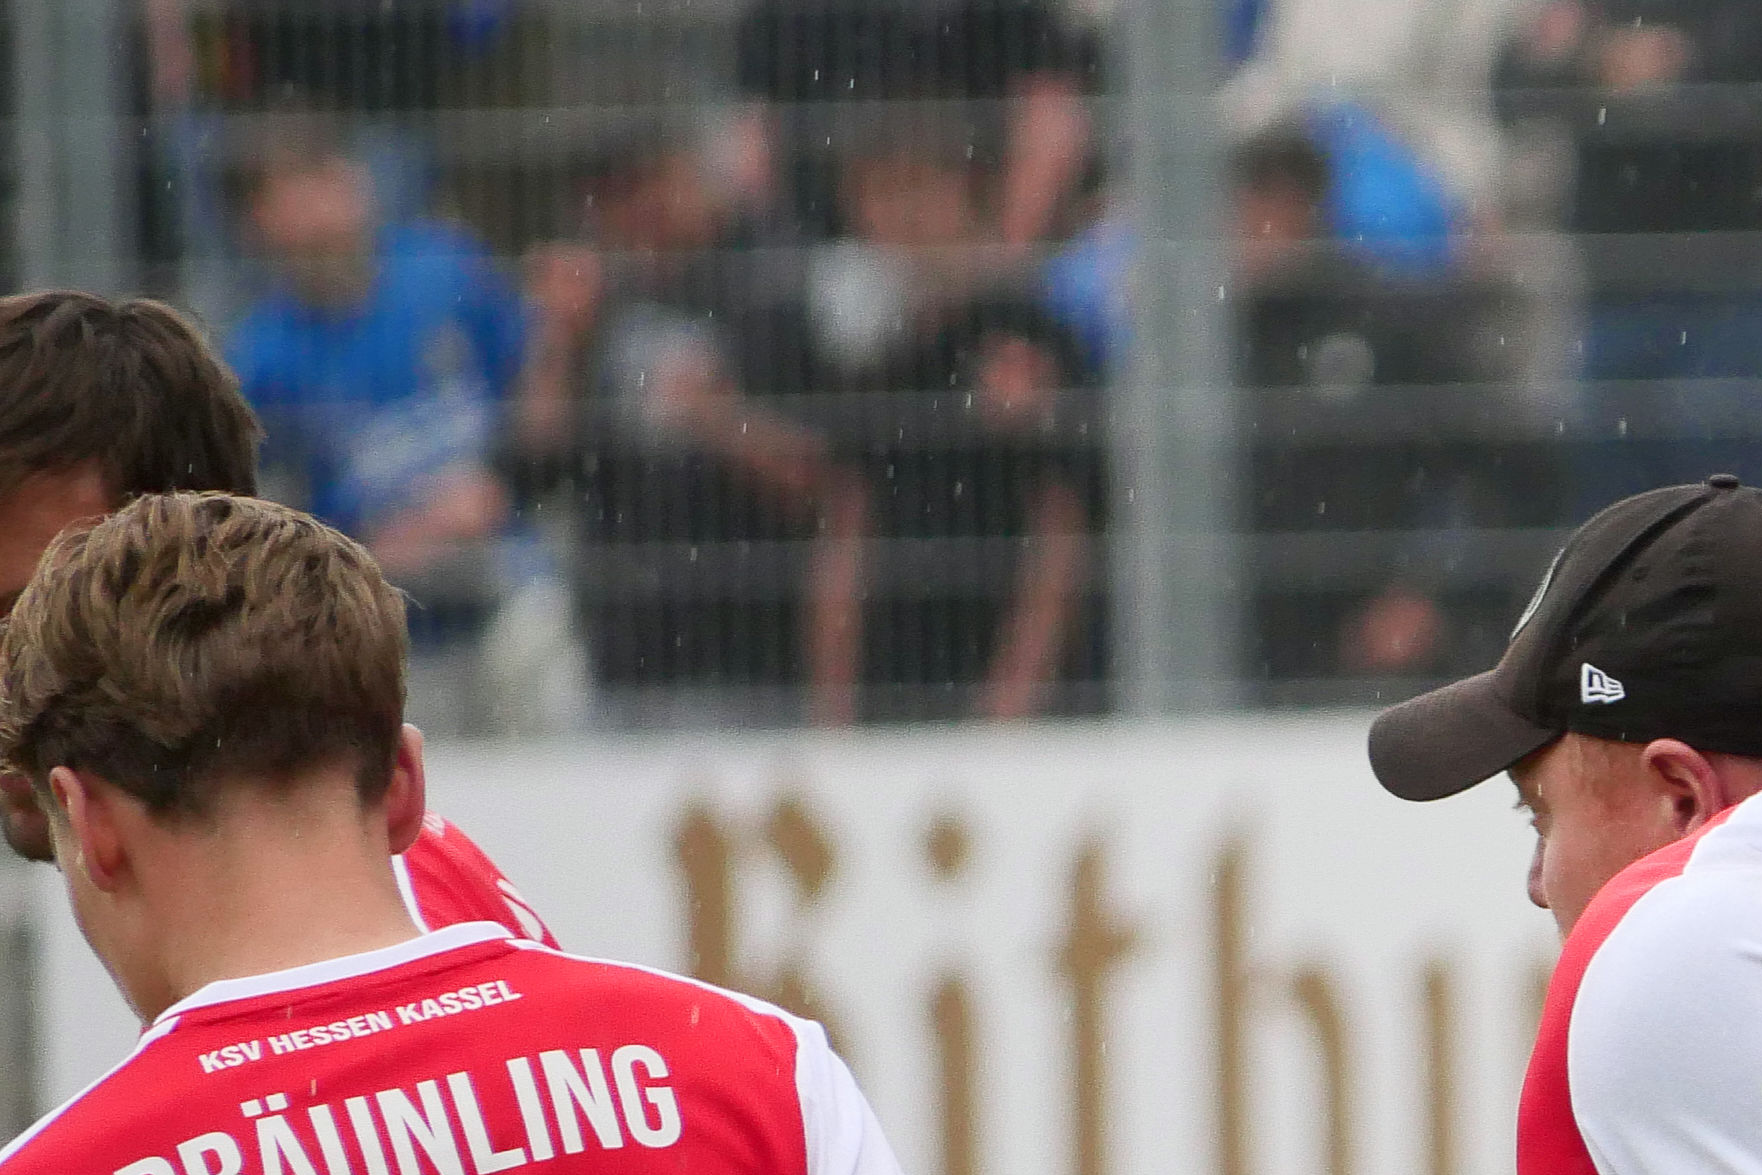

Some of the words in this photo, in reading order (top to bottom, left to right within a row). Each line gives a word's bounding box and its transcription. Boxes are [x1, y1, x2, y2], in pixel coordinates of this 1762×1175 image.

[199, 1040, 261, 1073] KSV
[269, 1010, 391, 1055] HESSEN
[398, 979, 521, 1025] KASSEL
